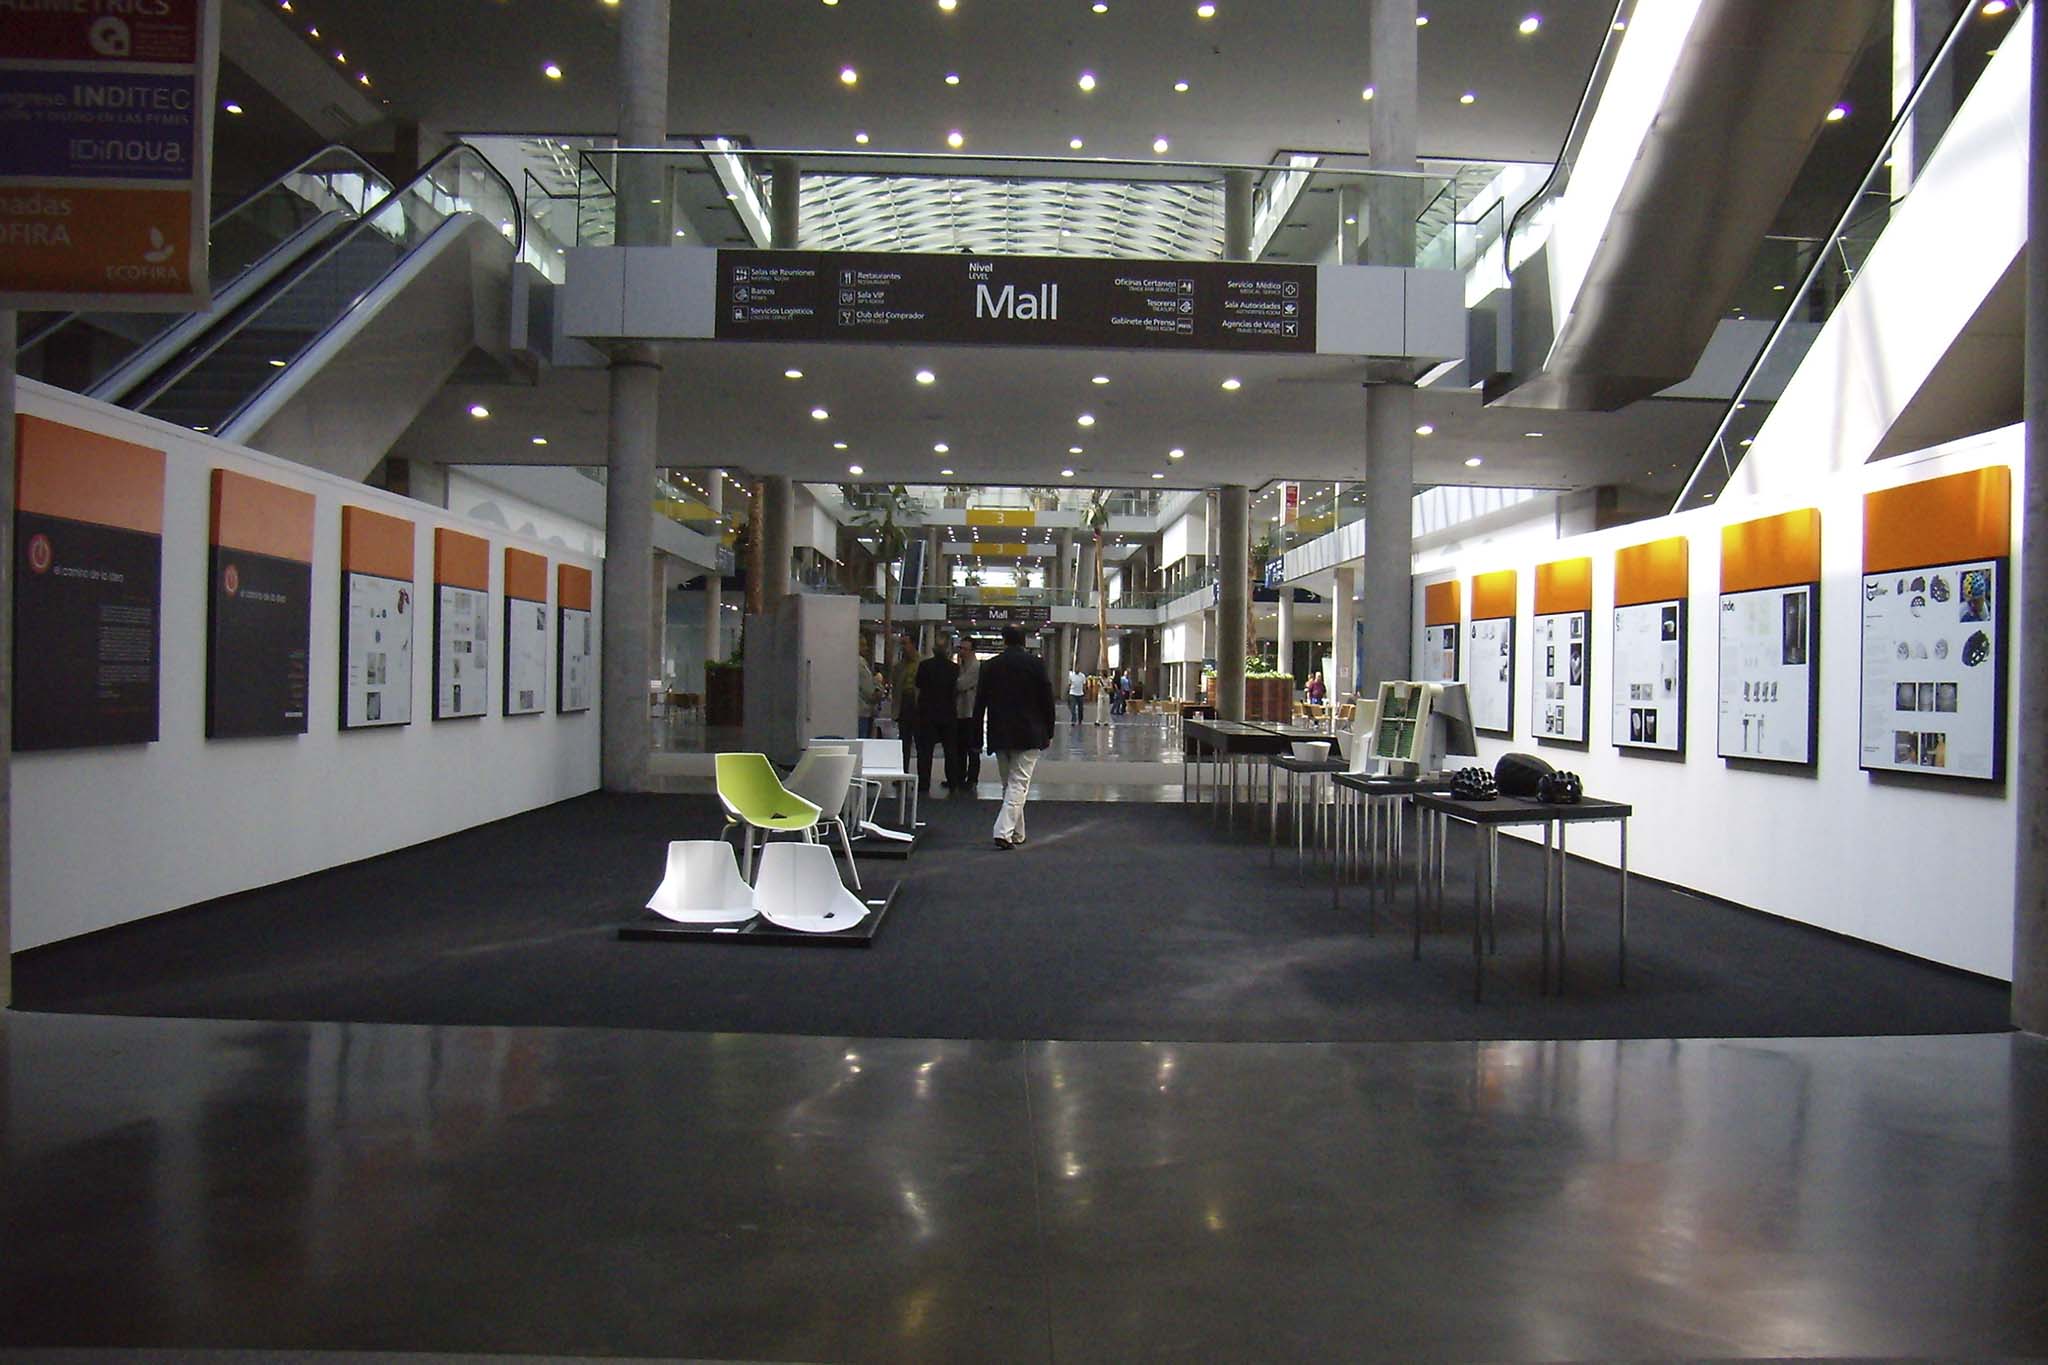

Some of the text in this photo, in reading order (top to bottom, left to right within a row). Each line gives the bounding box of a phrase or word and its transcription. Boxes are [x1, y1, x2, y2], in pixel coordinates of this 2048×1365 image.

[73, 84, 192, 110] INDITEC
[105, 264, 179, 281] ECOFIRA
[968, 262, 993, 273] Nivel
[857, 271, 902, 280] Restaurantes
[1143, 279, 1177, 287] Certamen
[751, 287, 775, 296] Bancos
[975, 283, 1058, 320] Mall
[1240, 301, 1281, 310] Autoridades
[856, 311, 926, 321] Club del Comprador
[997, 512, 1004, 524] 3
[988, 610, 1008, 620] Mall
